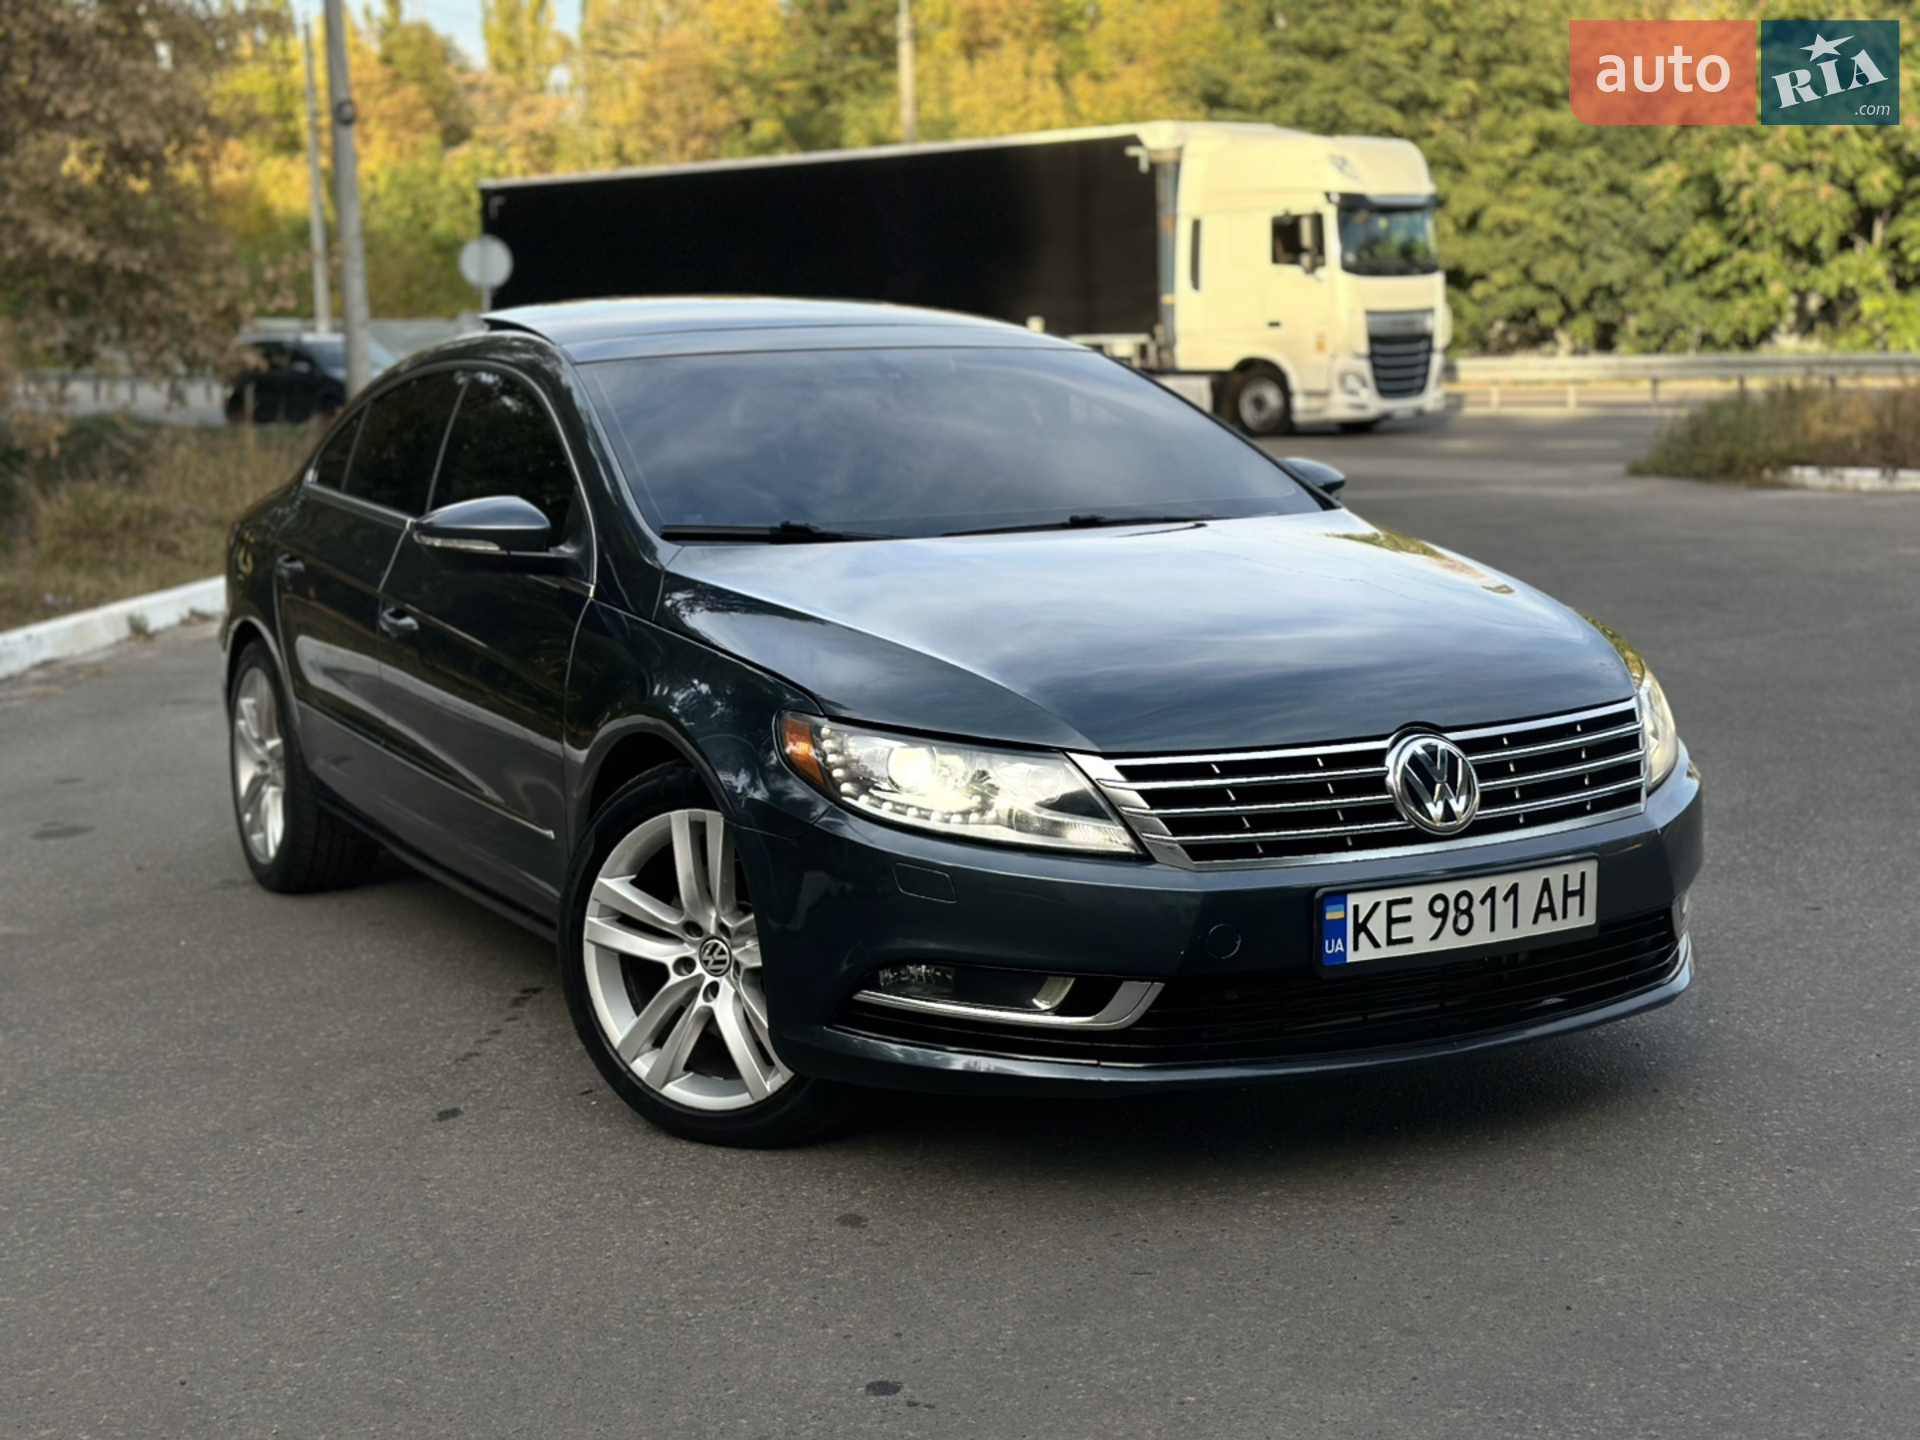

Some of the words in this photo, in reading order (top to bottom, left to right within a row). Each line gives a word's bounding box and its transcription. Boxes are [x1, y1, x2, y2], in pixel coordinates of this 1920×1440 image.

[1352, 896, 1414, 952] KE
[1427, 882, 1519, 942] 9811
[1532, 871, 1586, 925] AH
[1325, 938, 1345, 954] UA
